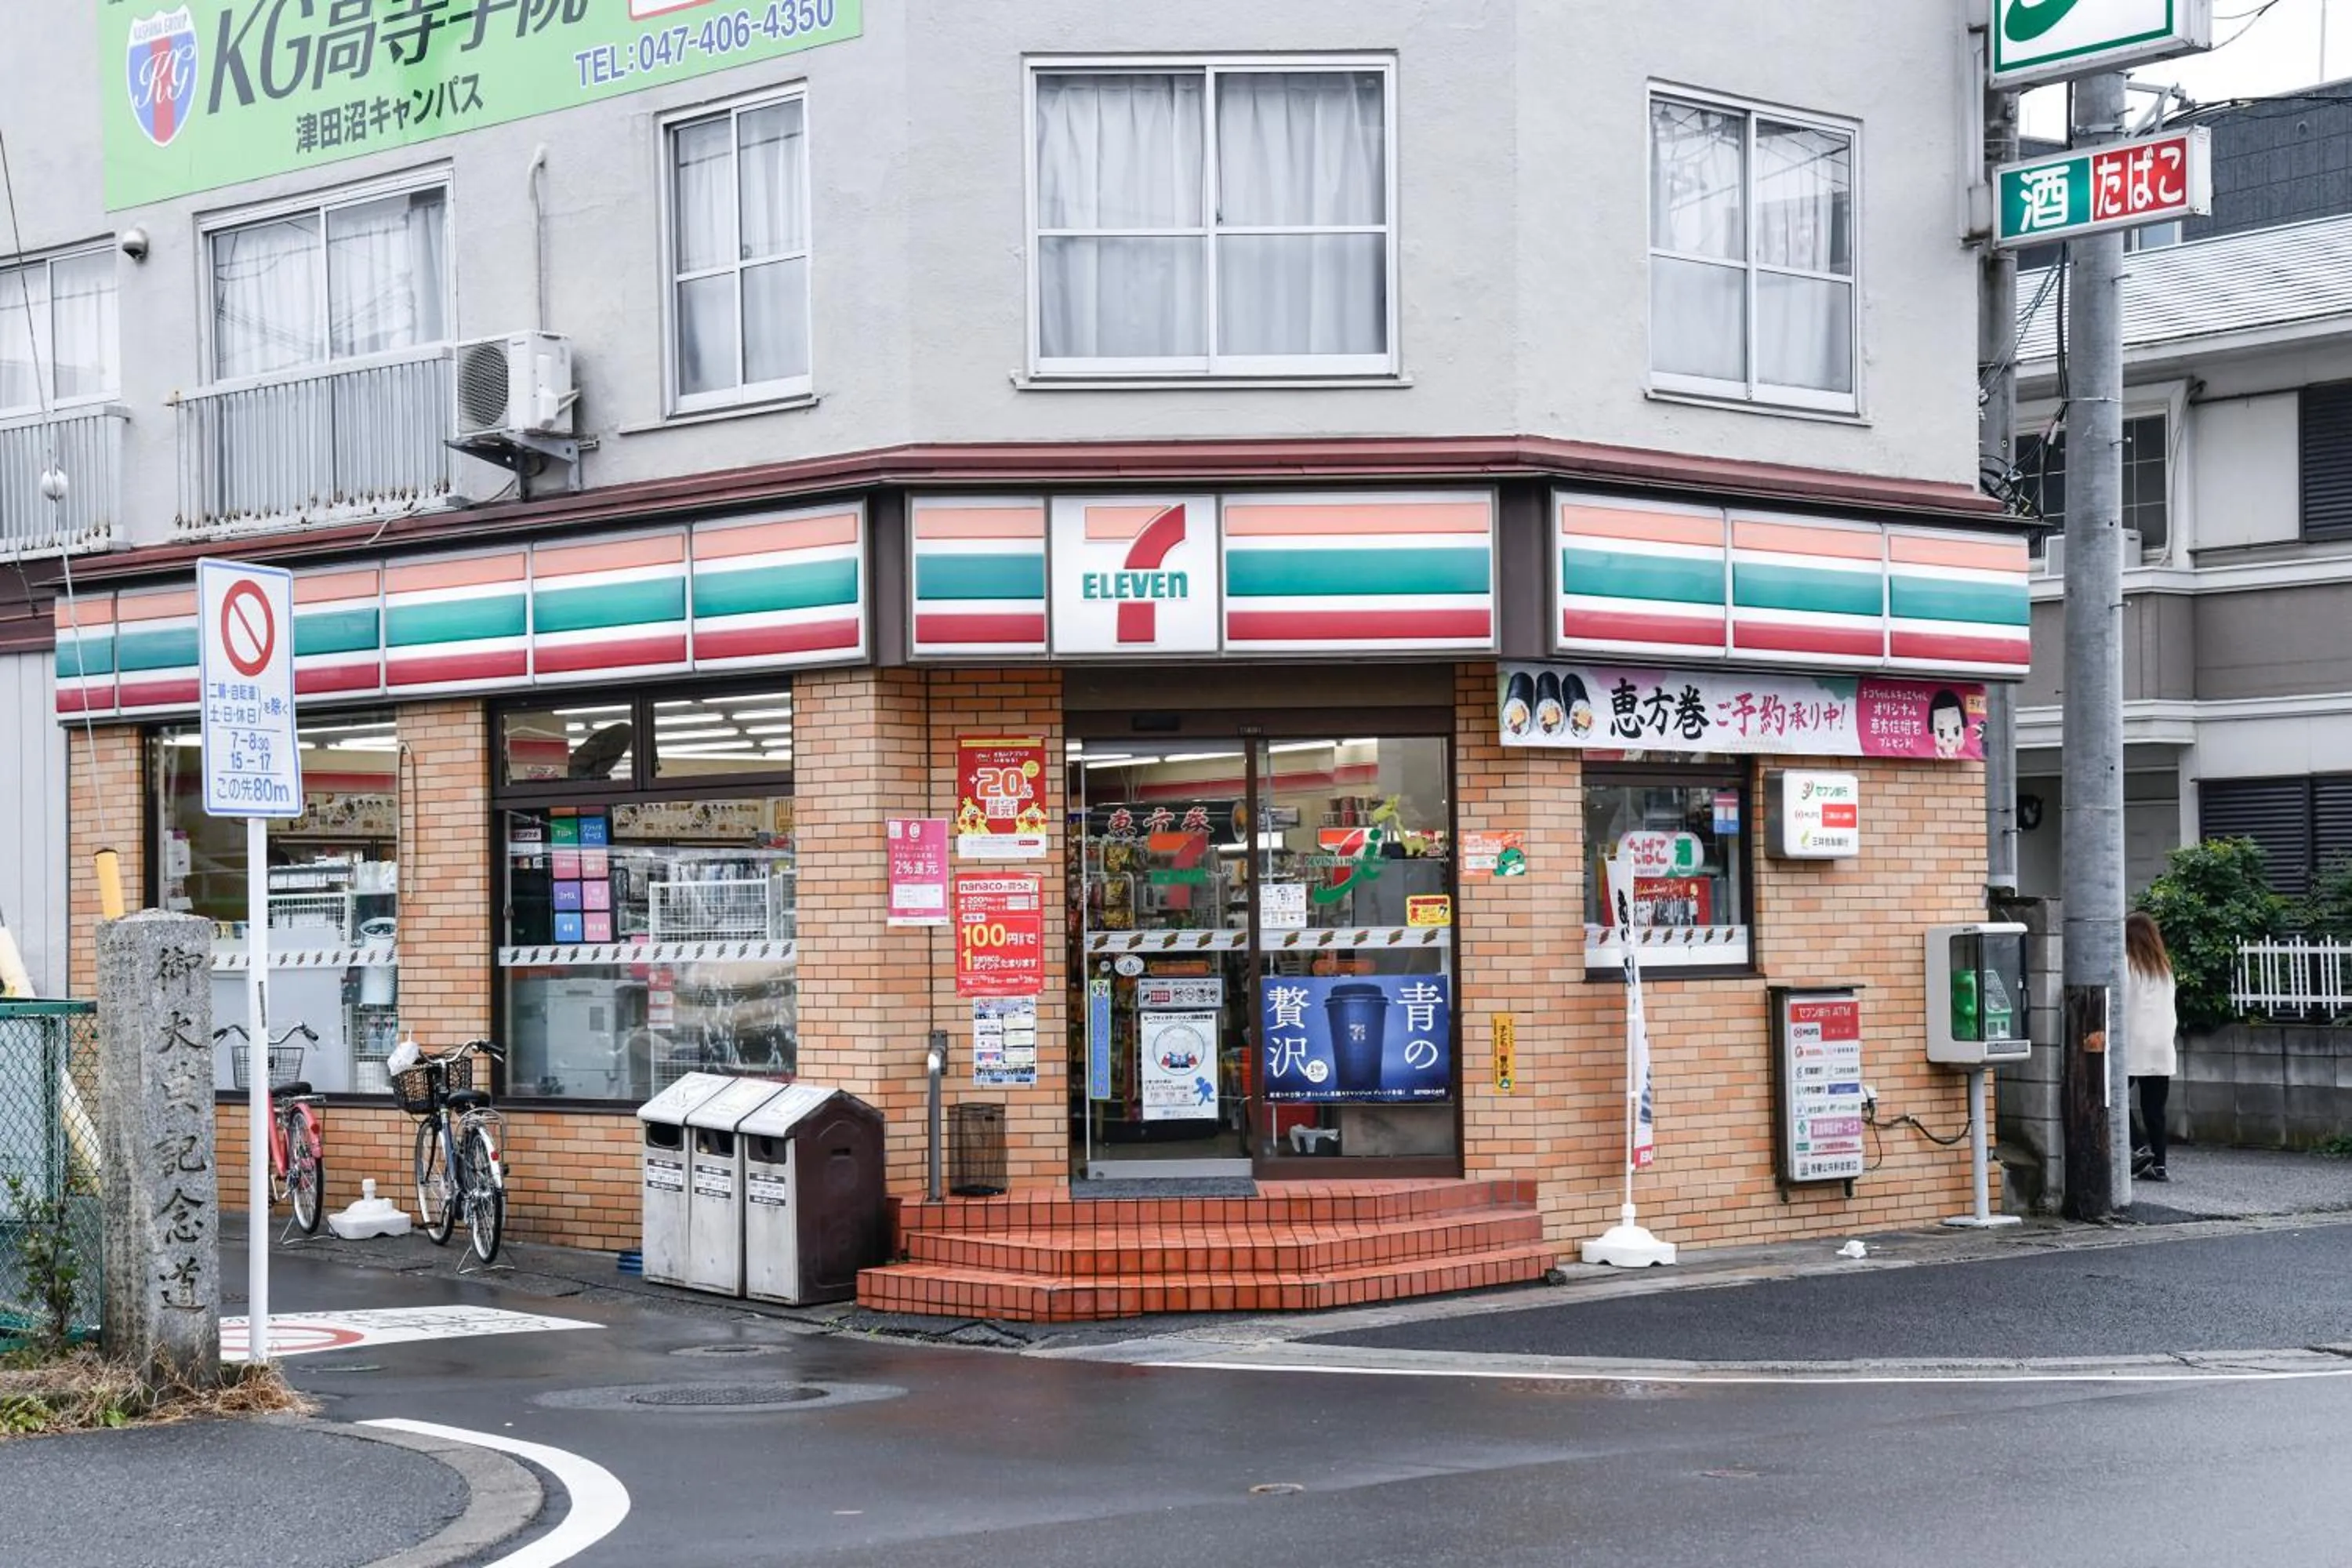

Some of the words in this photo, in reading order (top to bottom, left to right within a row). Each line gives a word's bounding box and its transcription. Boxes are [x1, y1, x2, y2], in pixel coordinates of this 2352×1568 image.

[575, 0, 834, 88] TEL:047-406-4350
[296, 73, 483, 154] 津田沼キャンパス
[2020, 165, 2070, 231] 酒
[2096, 146, 2183, 217] たばこ
[217, 777, 289, 803] この先80m
[1267, 985, 1312, 1078] 贅沢
[1397, 982, 1443, 1069] 青の
[1832, 1006, 1851, 1017] ATM
